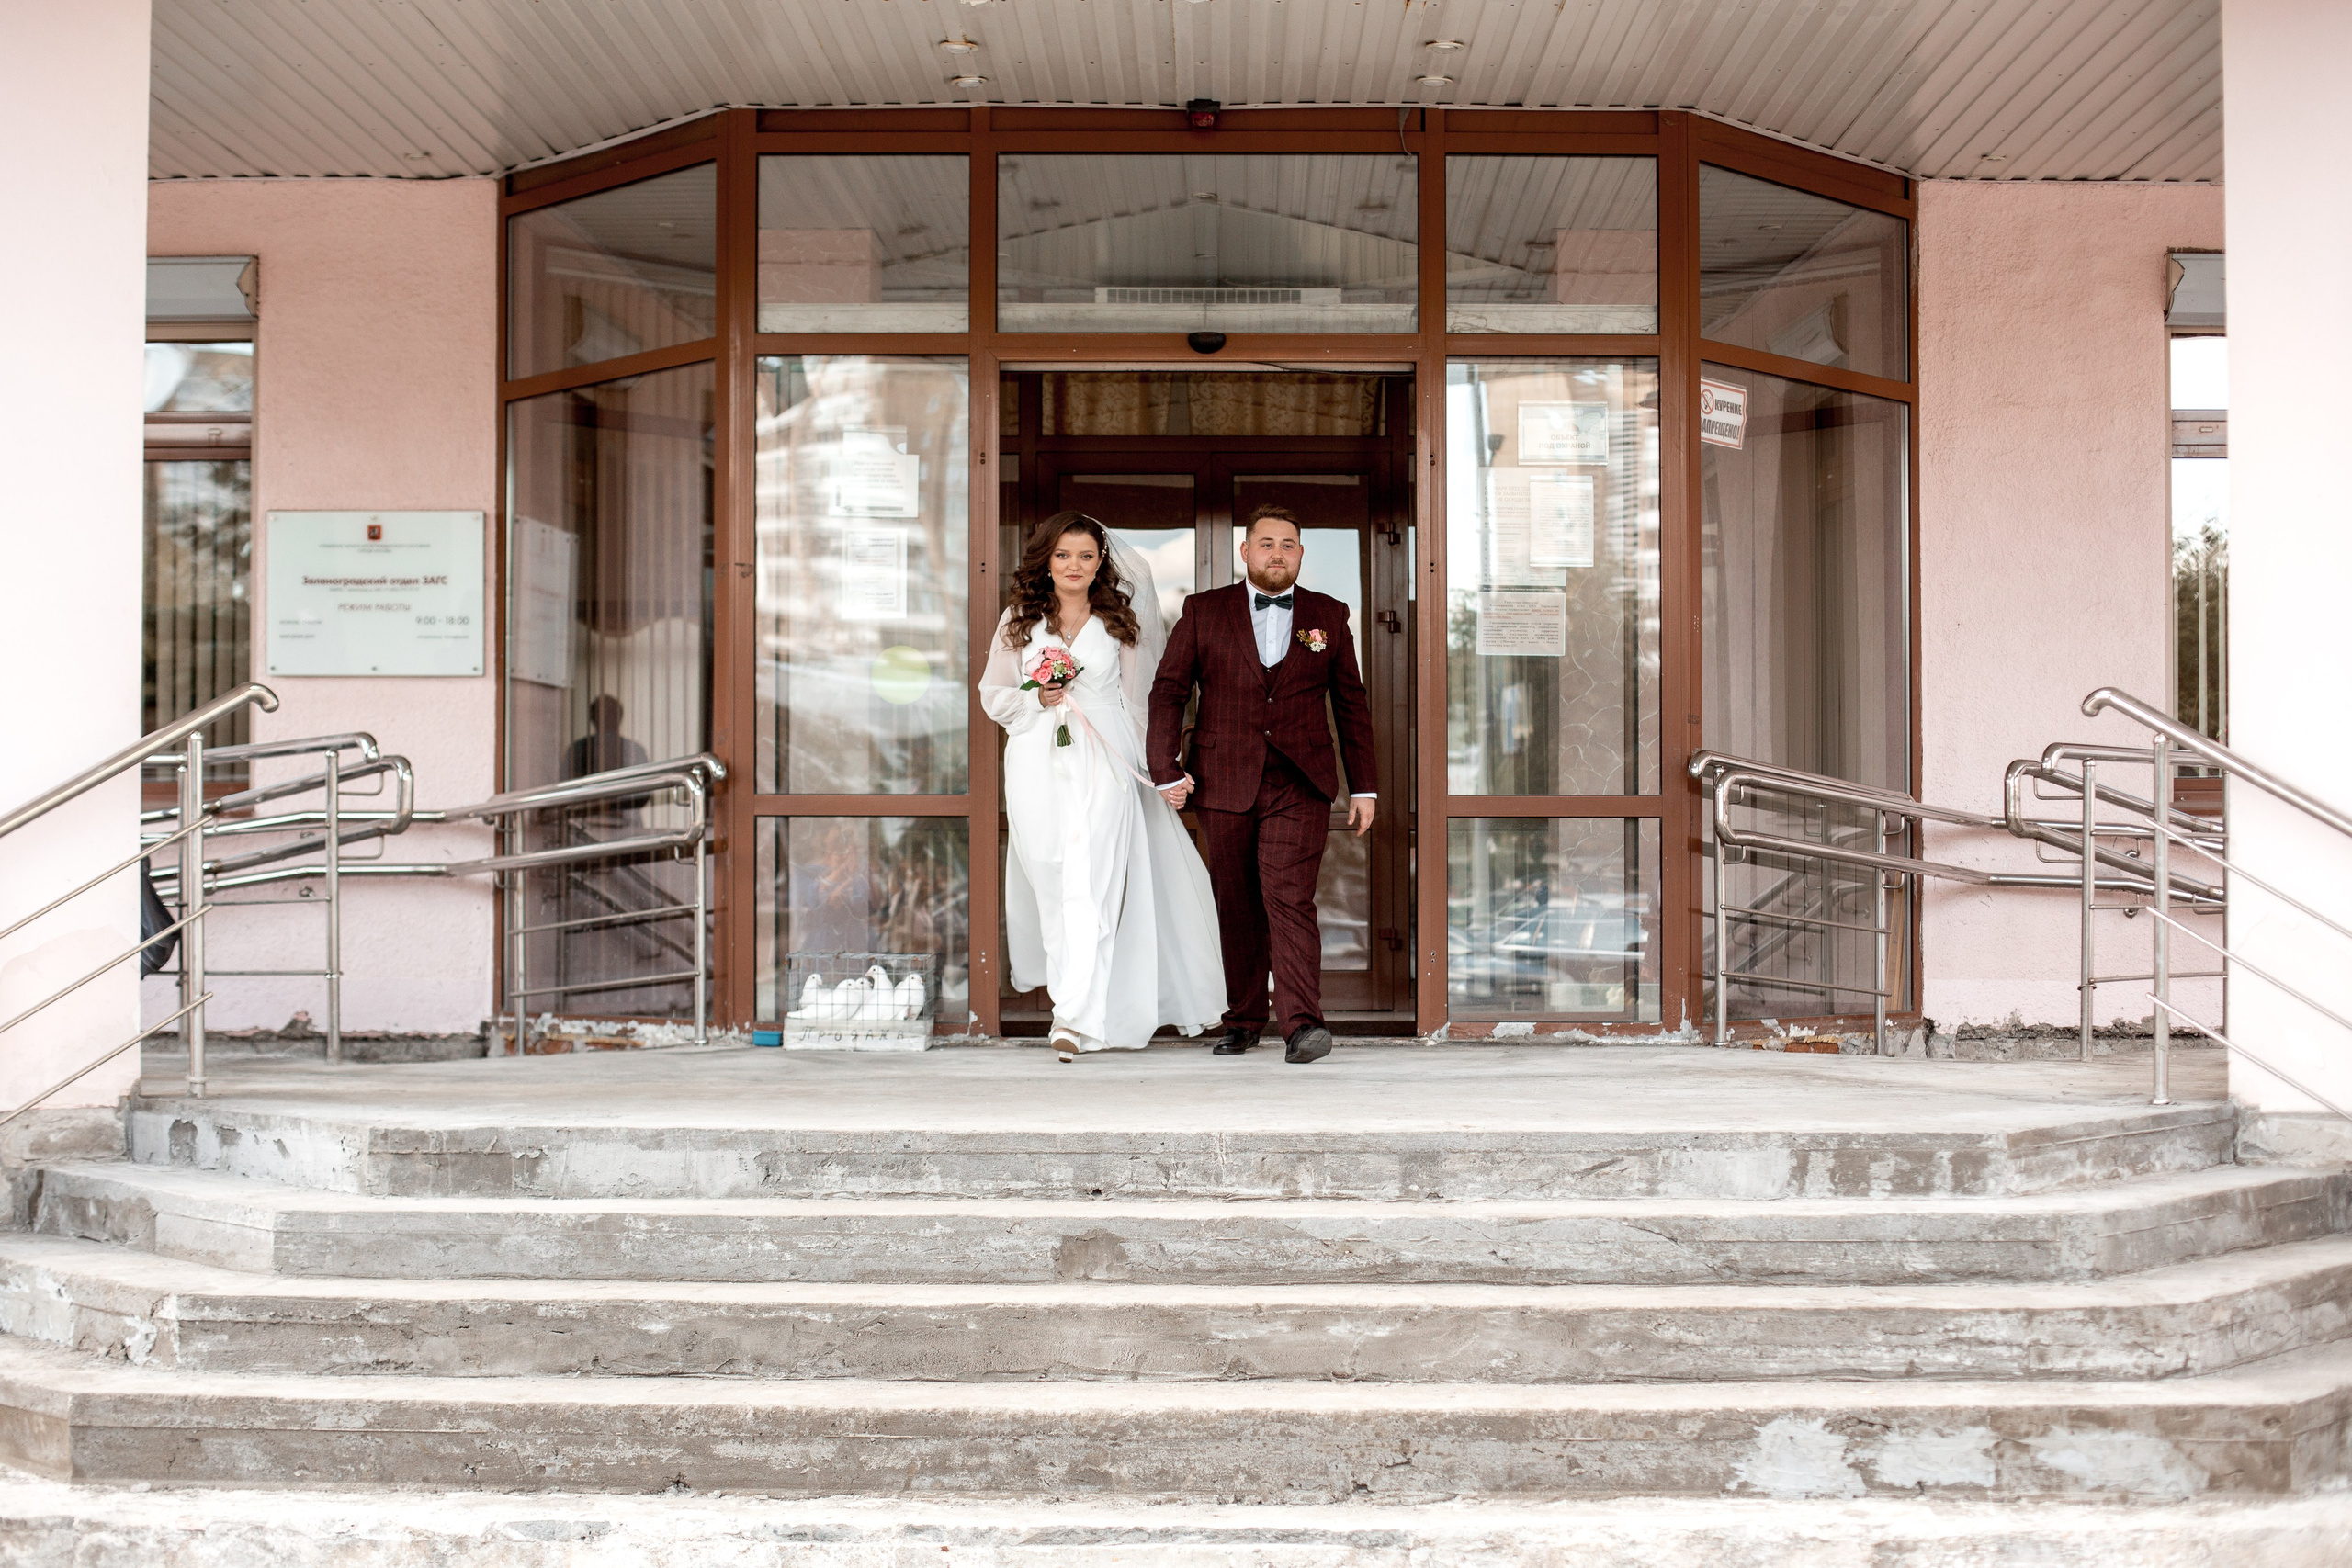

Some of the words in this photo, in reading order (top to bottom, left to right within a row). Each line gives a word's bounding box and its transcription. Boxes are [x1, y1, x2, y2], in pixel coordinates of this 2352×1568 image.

[1714, 399, 1742, 415] КУРЕНИЕ
[302, 575, 387, 586] Зеленоградский
[390, 578, 419, 586] отдел
[423, 575, 448, 585] ЗАГС
[337, 604, 371, 612] РЕЖИМ
[374, 604, 411, 612] РАБОТЫ
[415, 616, 436, 626] 9:00
[445, 616, 469, 626] 18:00
